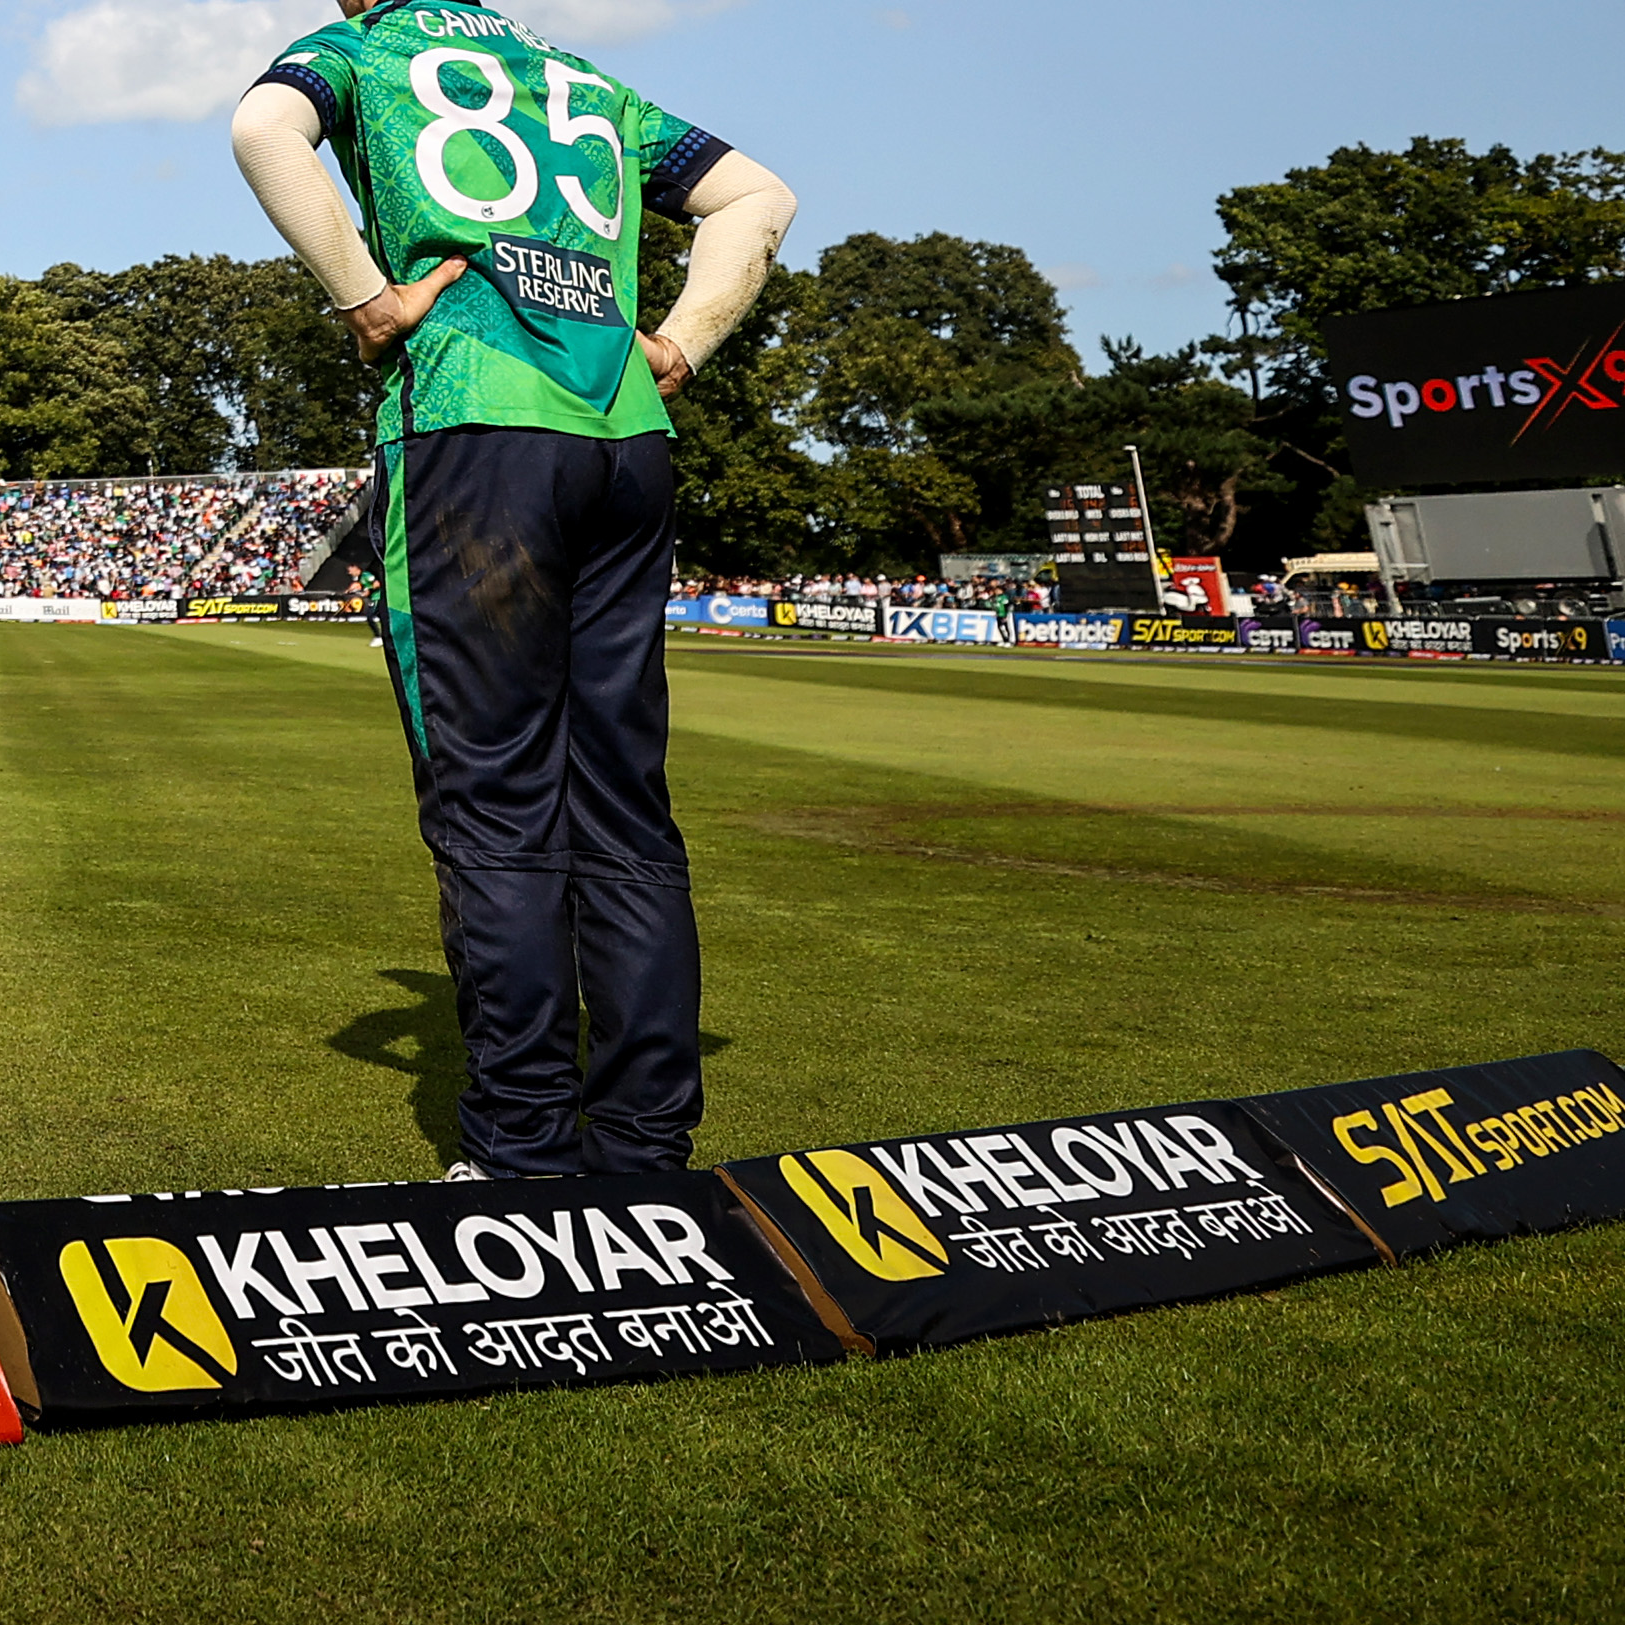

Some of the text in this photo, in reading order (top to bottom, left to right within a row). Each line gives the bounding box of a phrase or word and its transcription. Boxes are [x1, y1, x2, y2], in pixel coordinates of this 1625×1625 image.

[409, 47, 625, 241] 85
[494, 241, 614, 300] STERLING
[518, 275, 605, 318] RESERVE
[43, 605, 70, 616] Mail
[116, 599, 179, 613] KHELOYAR
[729, 605, 768, 619] certa
[797, 603, 876, 624] KHELOYAR
[1249, 629, 1293, 648] CBTF
[1308, 630, 1354, 649] CBTF
[1386, 620, 1471, 641] KHELOYAR
[871, 1115, 1264, 1219] KHELOYAR
[948, 1213, 1050, 1274] जीत
[1092, 1209, 1205, 1261] आदत
[1196, 1180, 1314, 1238] बनाओ
[197, 1203, 734, 1319] KHELOYAR
[251, 1317, 375, 1387] जीत
[465, 1312, 611, 1377] आदत
[603, 1282, 775, 1357] बनाओ
